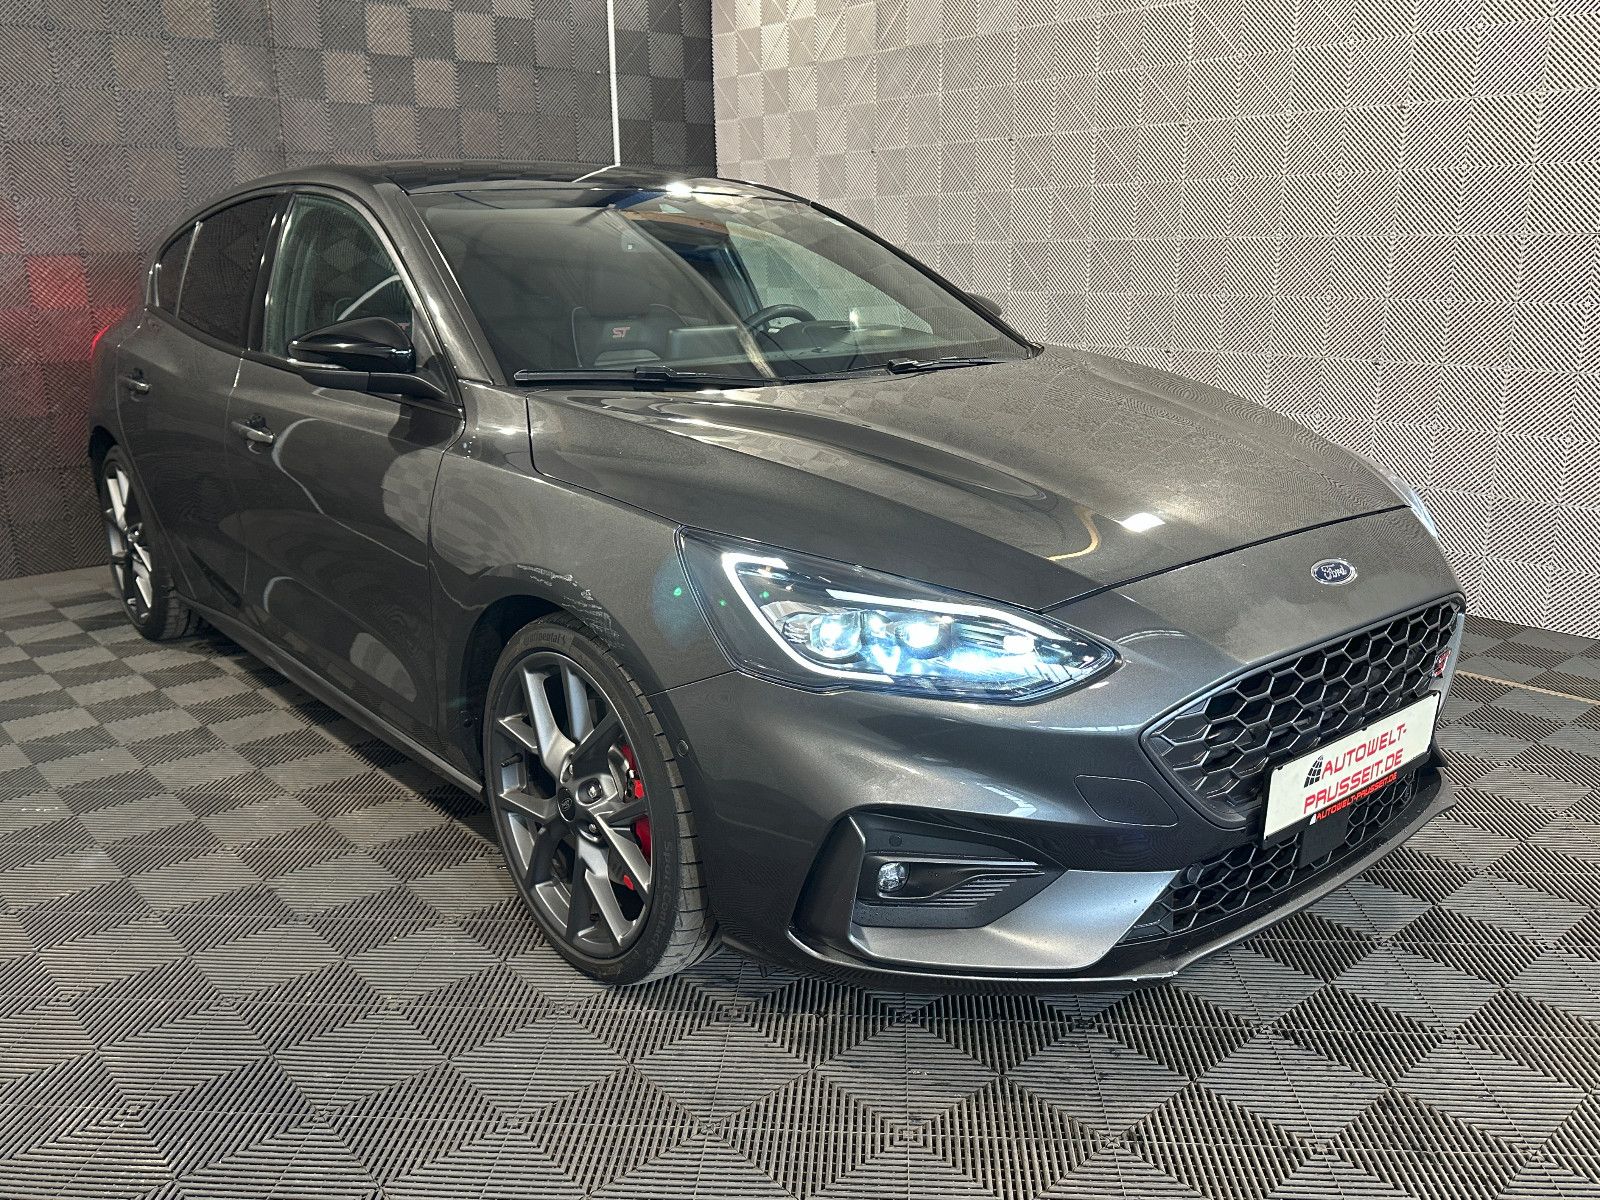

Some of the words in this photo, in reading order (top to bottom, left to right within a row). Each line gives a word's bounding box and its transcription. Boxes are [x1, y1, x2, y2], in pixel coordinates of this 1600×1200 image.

[612, 326, 631, 338] ST
[1320, 563, 1348, 580] Ford
[1321, 723, 1407, 780] AUTOWELT-
